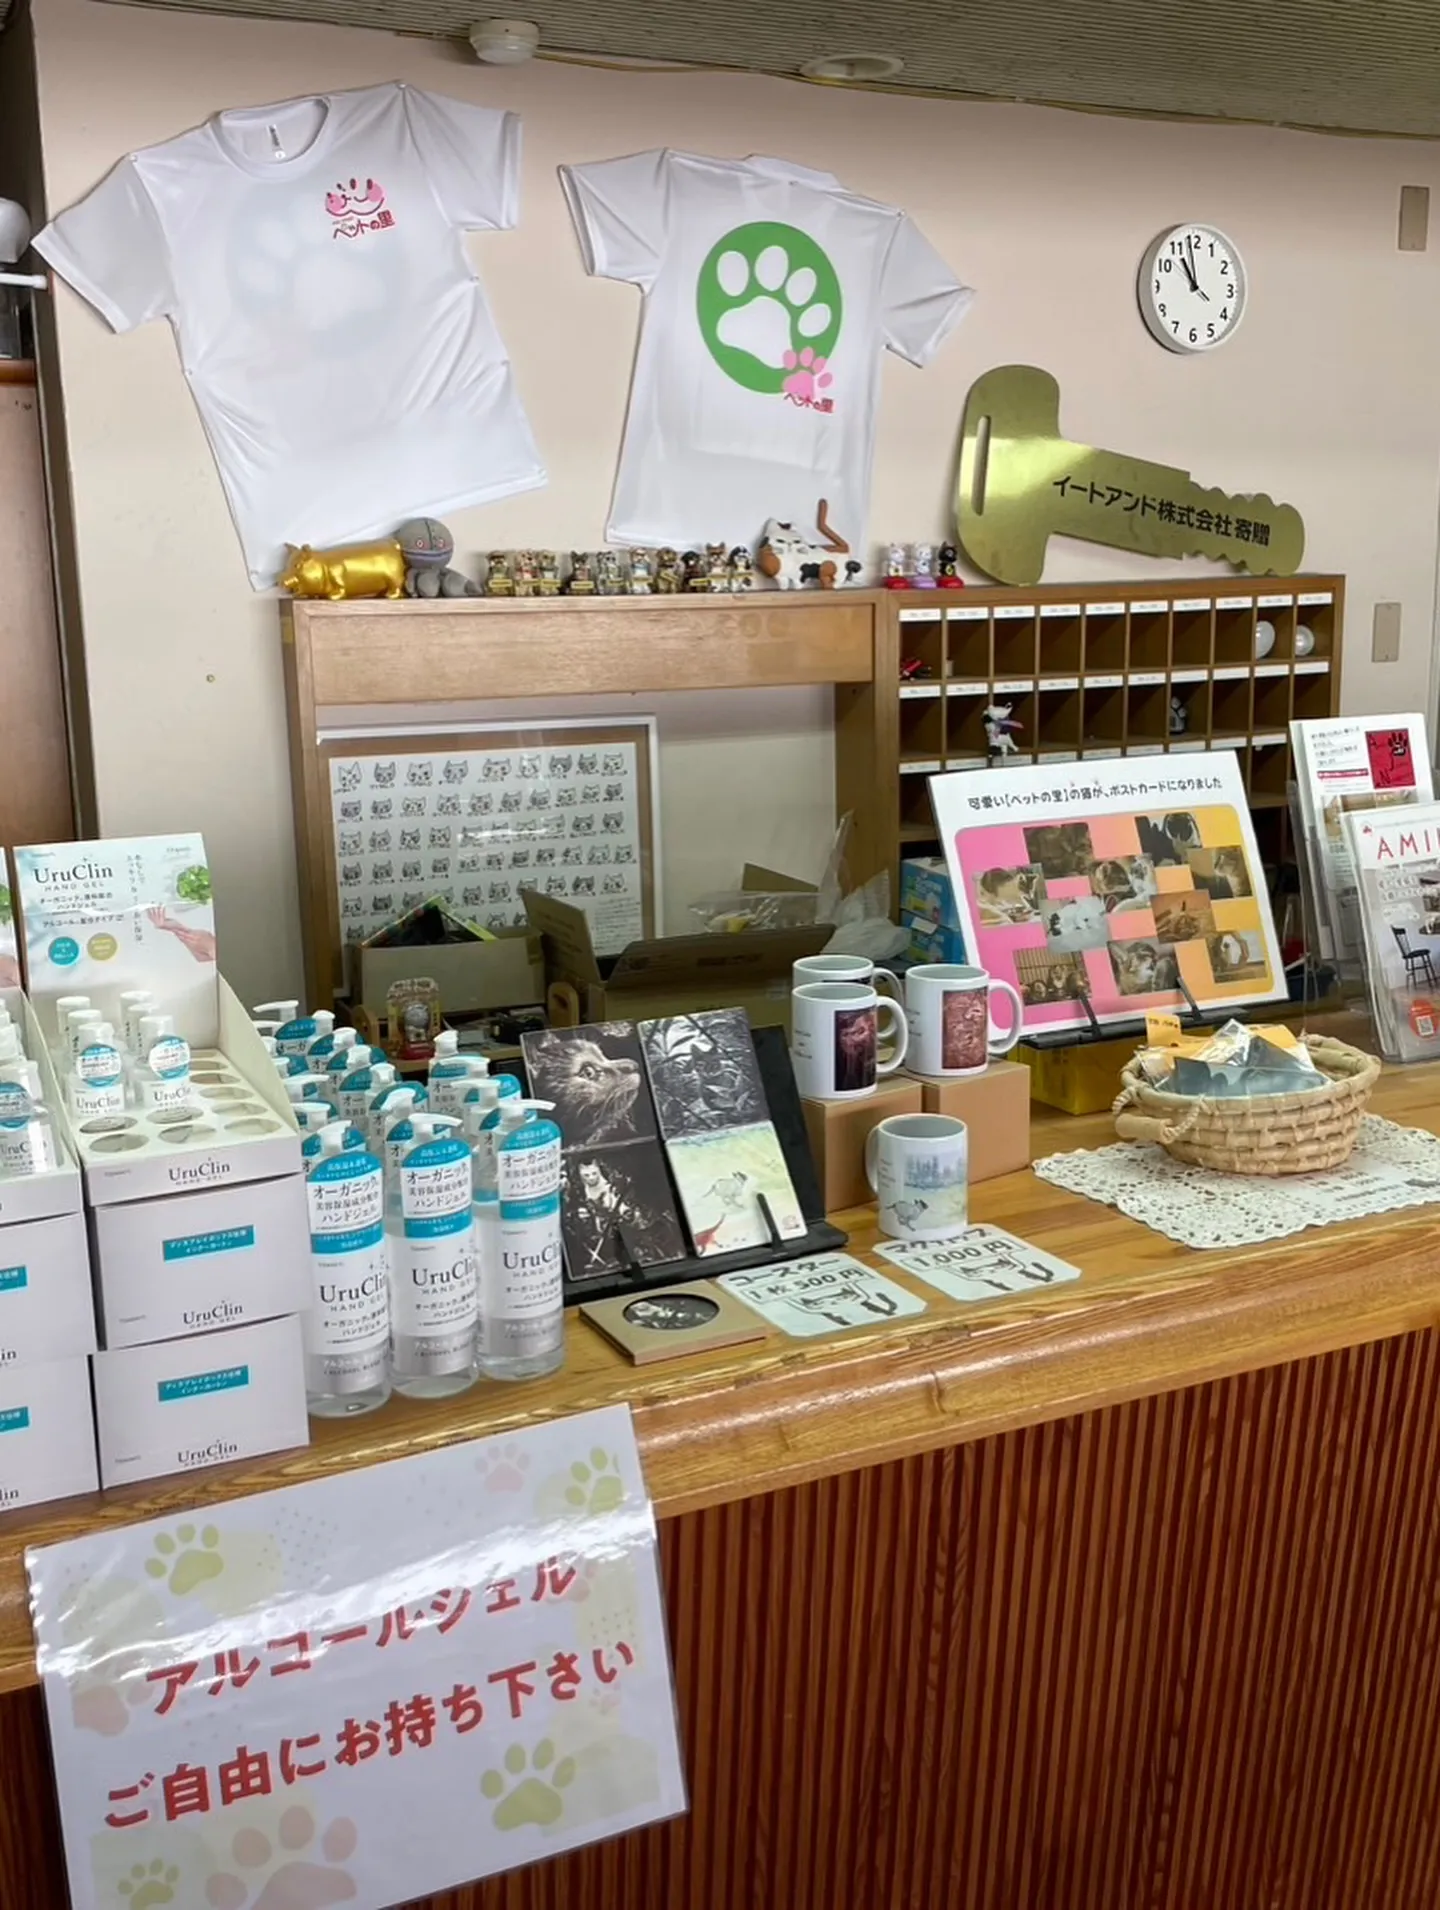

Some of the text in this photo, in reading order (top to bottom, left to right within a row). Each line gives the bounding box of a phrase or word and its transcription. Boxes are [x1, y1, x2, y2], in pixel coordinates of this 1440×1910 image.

[333, 210, 395, 239] ペットの里
[1170, 241, 1182, 255] 11
[1208, 243, 1214, 257] 1
[1158, 258, 1172, 273] 10
[1220, 260, 1228, 275] 2
[1227, 284, 1234, 299] 3
[1219, 307, 1228, 321] 4
[1171, 320, 1179, 334] 7
[1189, 328, 1197, 342] 6
[1207, 323, 1215, 337] 5
[1053, 476, 1271, 547] イートアンド株式会社寄贈
[34, 863, 113, 884] UruClin
[169, 1161, 230, 1181] UruClin
[407, 1162, 468, 1185] オーガニック
[314, 1175, 378, 1199] オーガニック
[728, 1259, 840, 1287] コースター
[183, 1304, 242, 1324] UruClin
[330, 1301, 365, 1312] HAND
[178, 1443, 237, 1463] UruClin
[104, 1641, 634, 1829] ご自由にお持ち下さい
